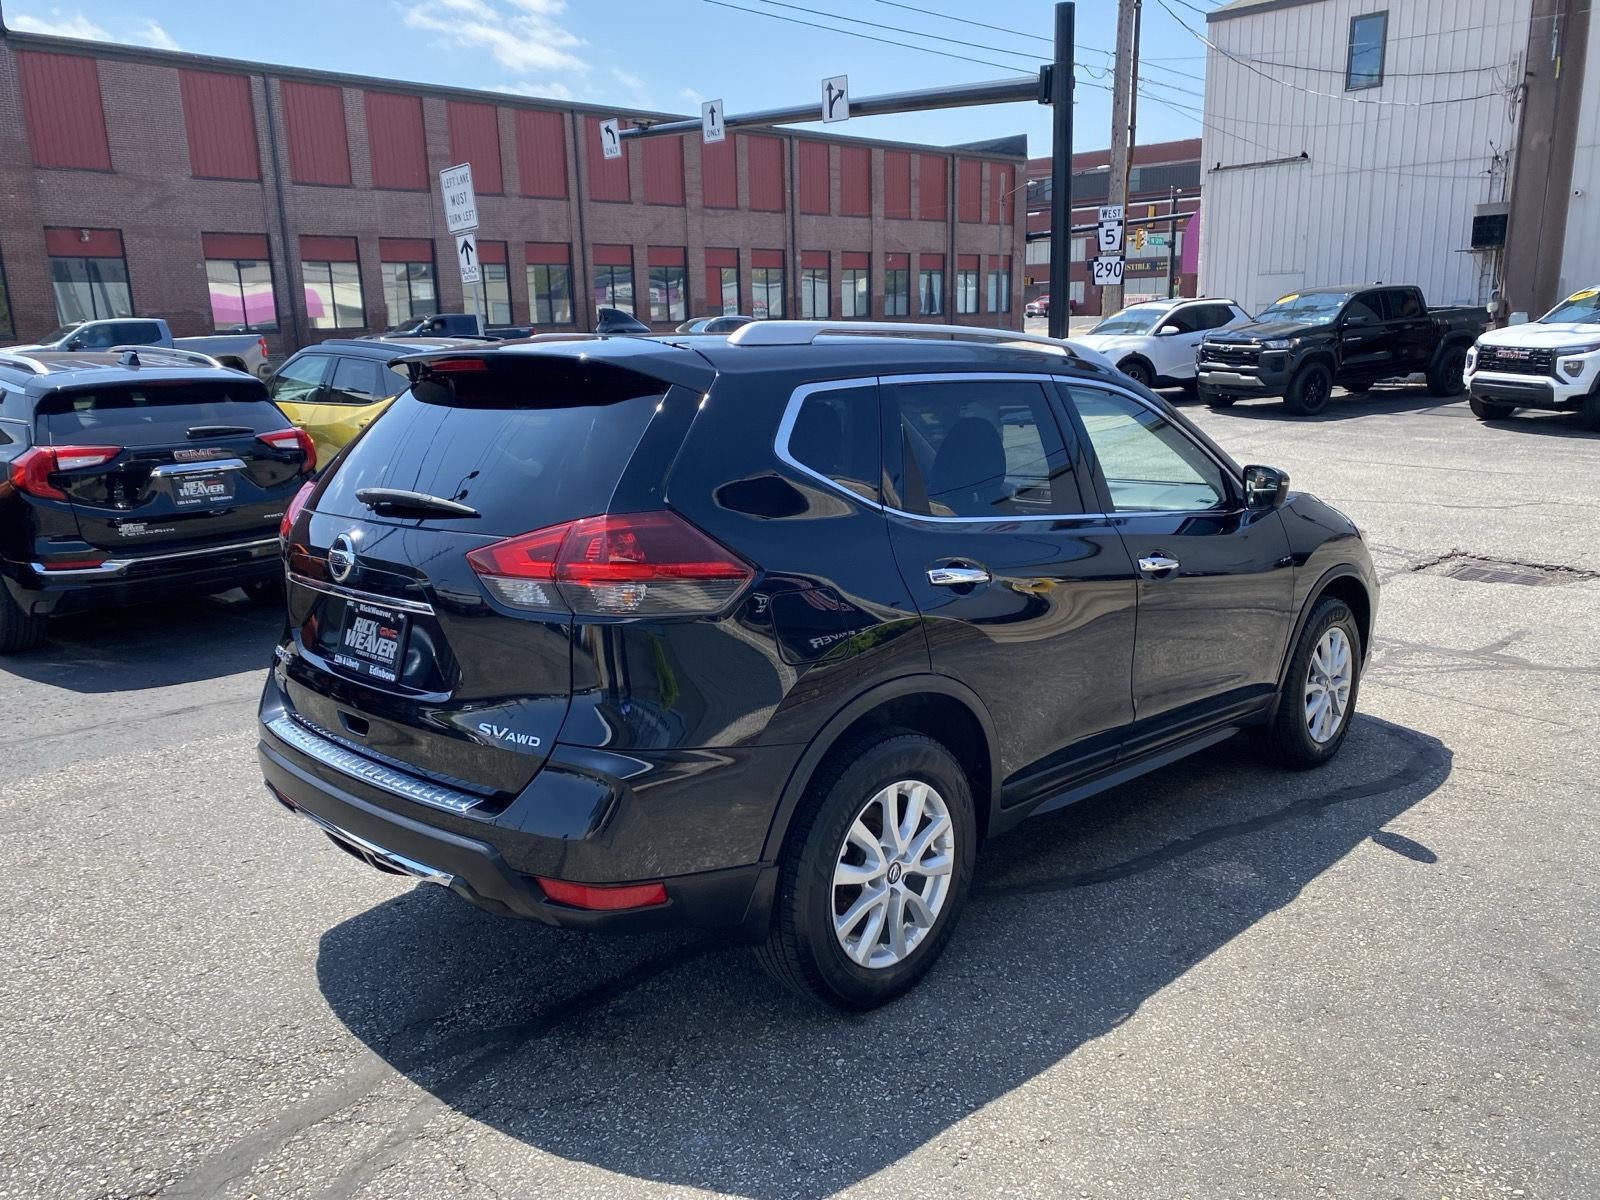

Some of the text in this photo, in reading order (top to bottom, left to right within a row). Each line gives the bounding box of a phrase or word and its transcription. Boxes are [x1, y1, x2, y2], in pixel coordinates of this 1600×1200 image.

[706, 128, 720, 137] ONLY
[606, 147, 618, 156] ONLY
[443, 173, 470, 189] LEFT LANE
[450, 192, 468, 207] MUST
[448, 209, 475, 225] TURN LEFT
[1102, 209, 1121, 219] WEST
[1105, 229, 1116, 245] 5
[1096, 261, 1122, 278] 290
[174, 448, 221, 461] GMC
[179, 484, 225, 497] WEAVER
[183, 481, 205, 490] RICK
[353, 617, 380, 635] RICK
[345, 629, 398, 659] WEAVER
[369, 664, 396, 682] Edinboro
[478, 722, 541, 747] SV AWD
